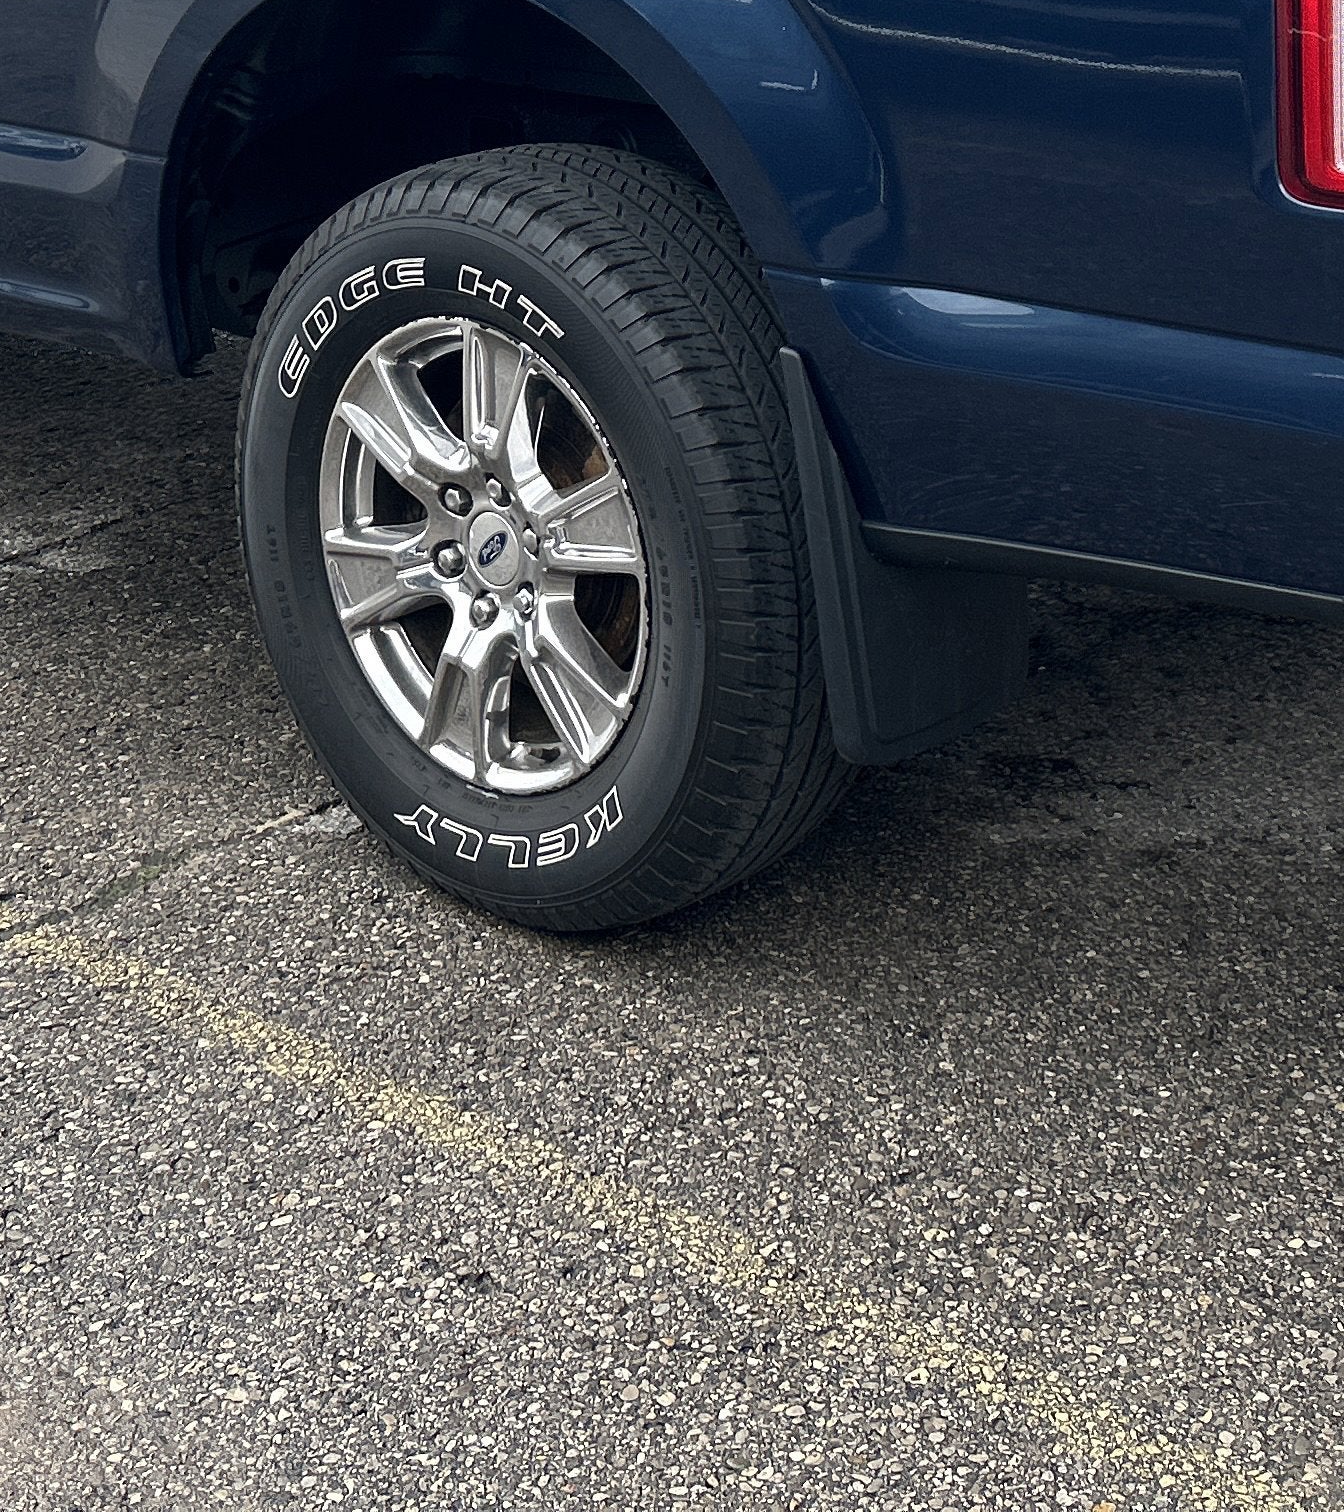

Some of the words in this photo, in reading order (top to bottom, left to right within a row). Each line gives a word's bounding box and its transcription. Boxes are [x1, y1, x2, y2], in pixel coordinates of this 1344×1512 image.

[278, 257, 426, 398] EDGE
[458, 264, 565, 339] HT
[393, 785, 624, 869] KELLY
